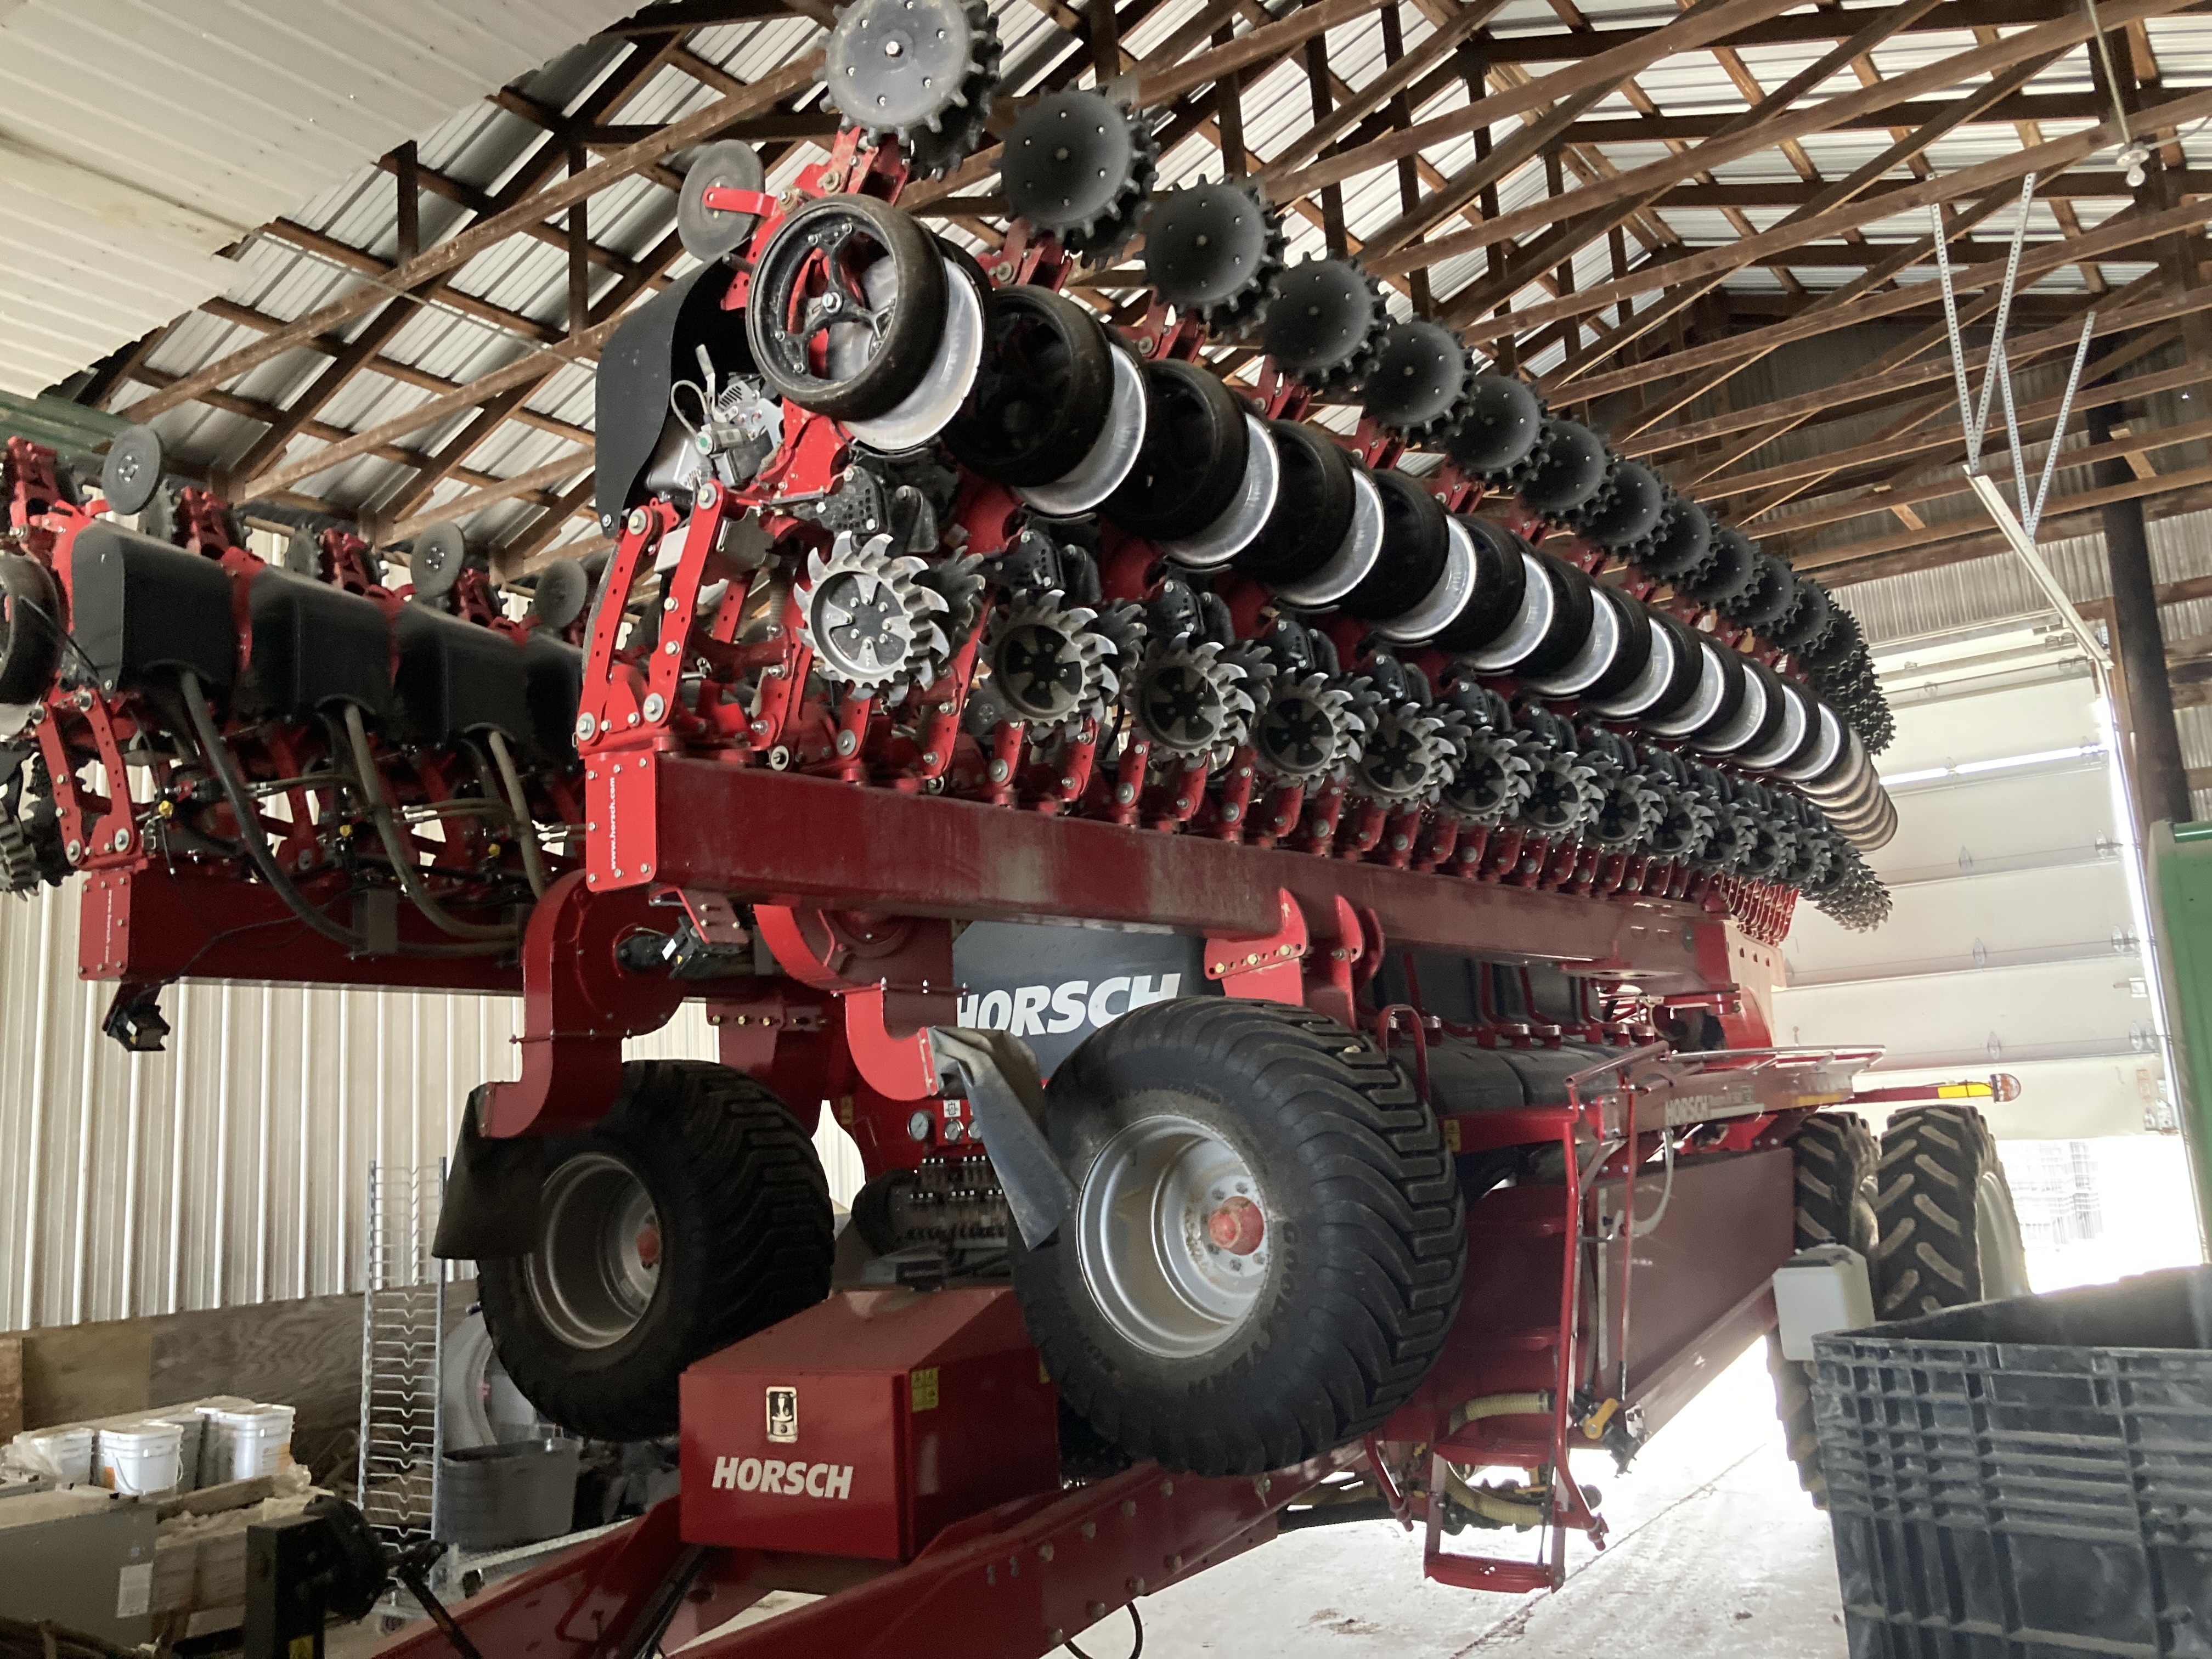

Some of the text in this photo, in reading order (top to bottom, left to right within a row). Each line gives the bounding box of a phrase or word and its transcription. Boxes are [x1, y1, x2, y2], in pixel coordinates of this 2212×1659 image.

[957, 973, 1181, 1037] HORSCH
[1664, 1094, 1709, 1126] HORSCH
[712, 1457, 854, 1499] HORSCH
